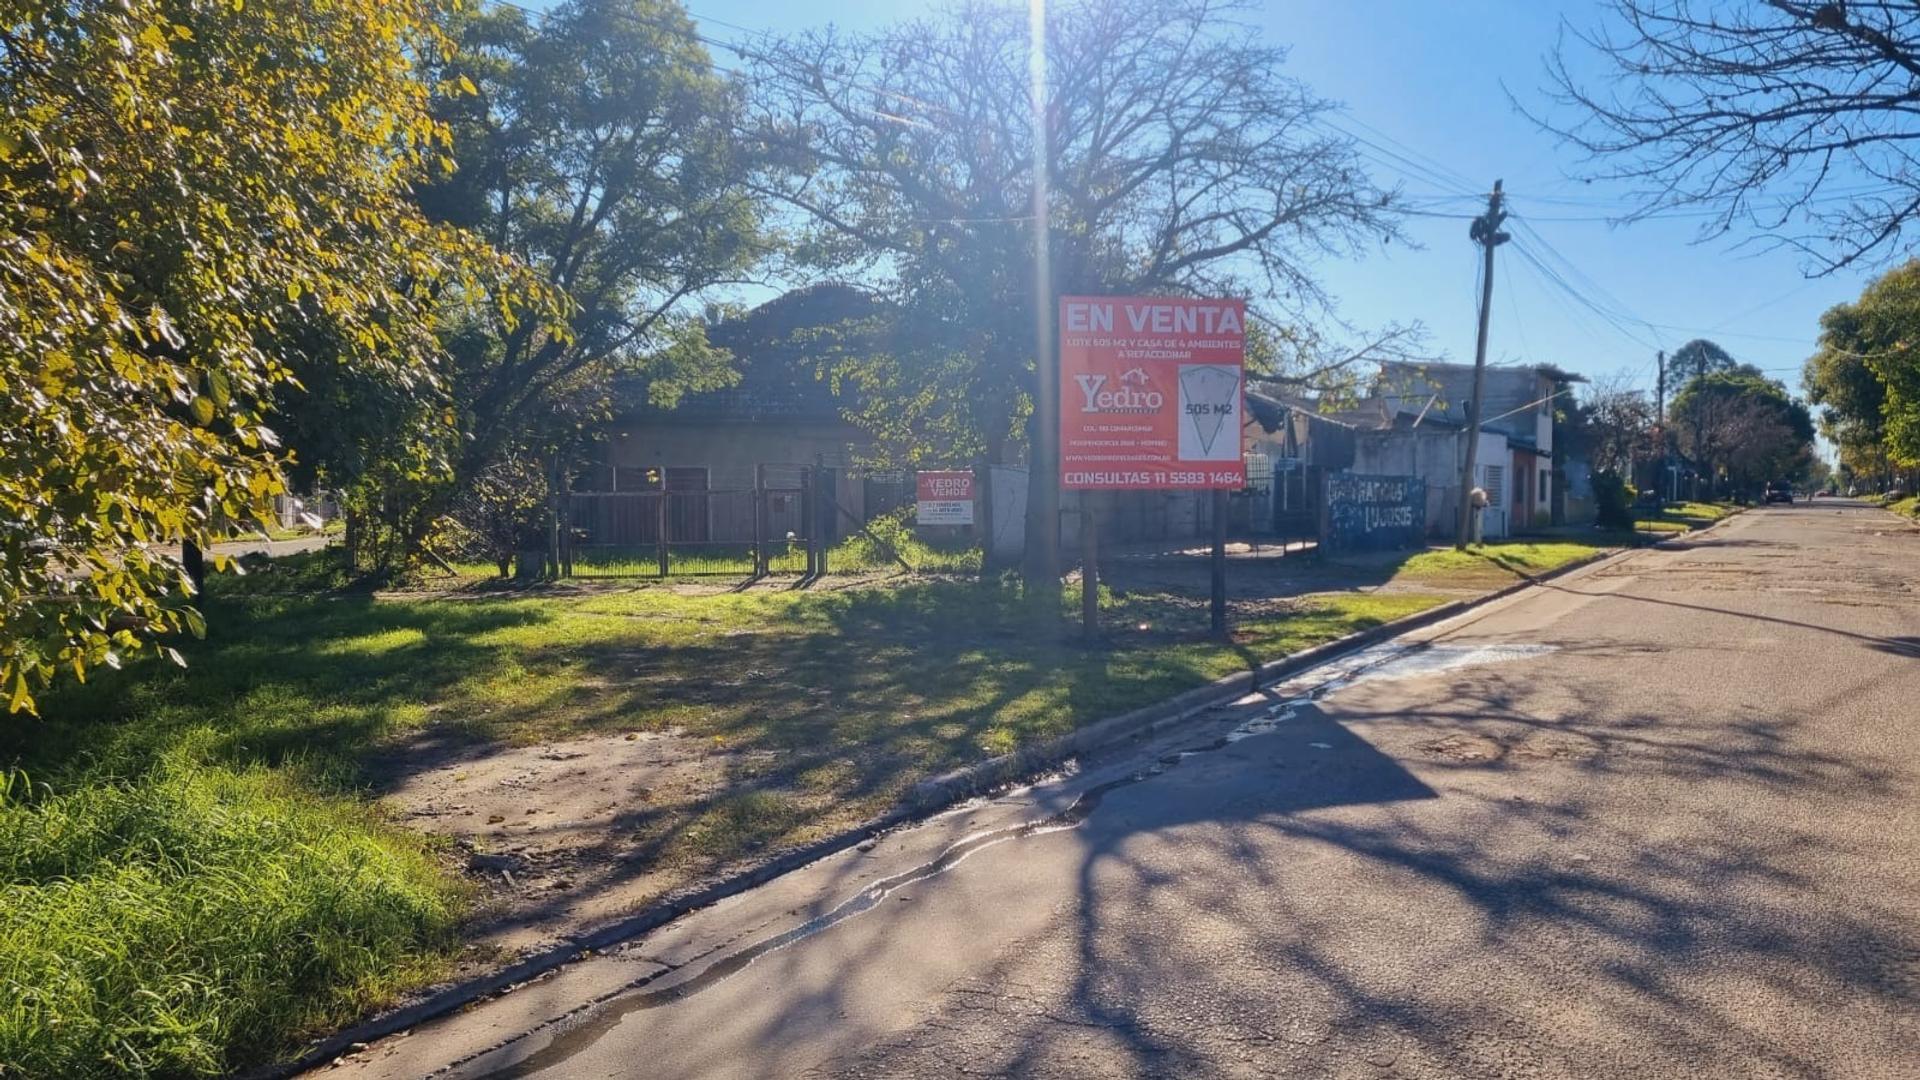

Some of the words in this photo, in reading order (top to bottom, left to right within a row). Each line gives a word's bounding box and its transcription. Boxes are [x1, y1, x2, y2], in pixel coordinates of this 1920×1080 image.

[1067, 304, 1113, 332] EN
[1125, 305, 1242, 334] VENTA
[1067, 339, 1091, 347] LOTE
[1111, 339, 1126, 347] M2
[1129, 339, 1136, 347] Y
[1137, 339, 1162, 348] CASA
[1164, 339, 1177, 348] DE
[1188, 339, 1241, 349] AMBIENTES
[1118, 350, 1126, 358] A
[1127, 350, 1191, 359] REFACCIONAR
[1074, 374, 1163, 412] Yedro
[1185, 404, 1210, 414] 505
[1214, 404, 1233, 414] M2
[928, 478, 970, 488] YEDRO
[1064, 472, 1150, 484] CONSULTAS
[1154, 473, 1166, 483] 11
[1169, 473, 1205, 484] 5583
[1210, 472, 1243, 484] 1464
[931, 488, 967, 496] VENDE
